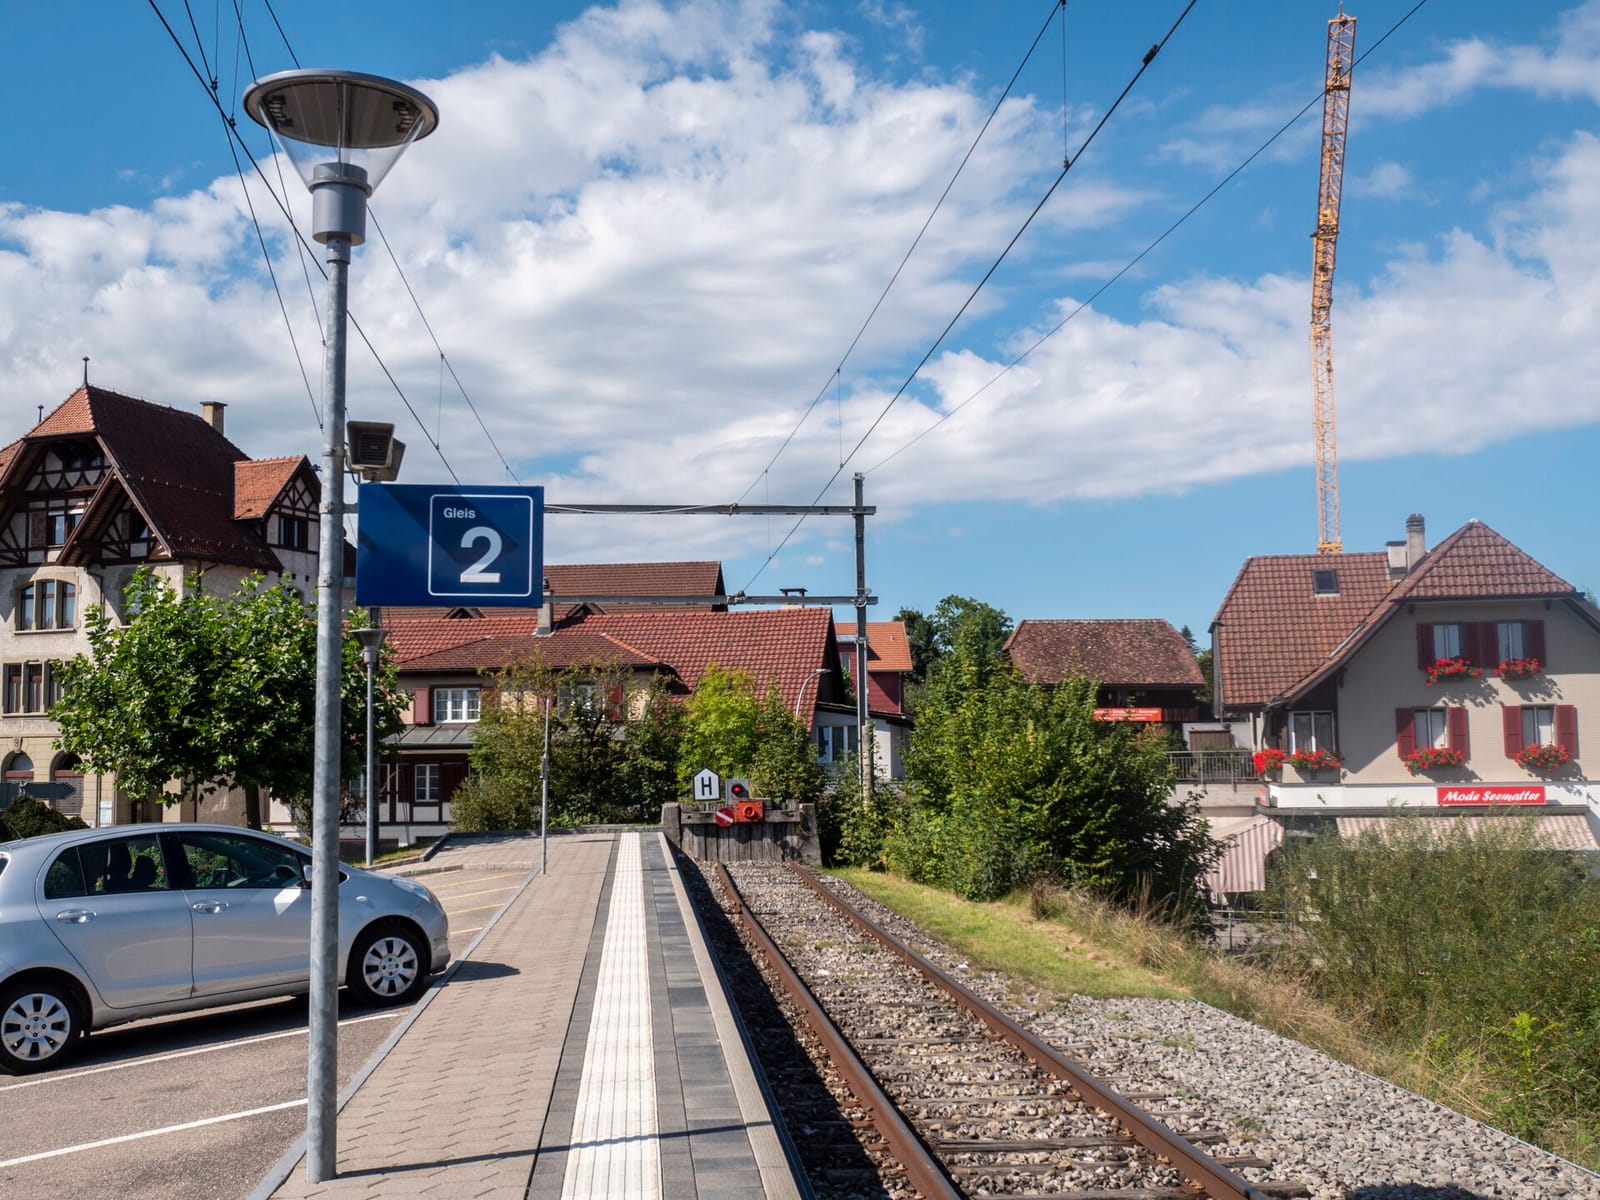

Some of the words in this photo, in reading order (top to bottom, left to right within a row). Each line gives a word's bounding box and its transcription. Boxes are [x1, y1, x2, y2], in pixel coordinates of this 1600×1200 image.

[443, 507, 476, 519] Gleis
[460, 526, 502, 583] 2
[701, 776, 712, 796] H
[1443, 791, 1480, 801] Mode
